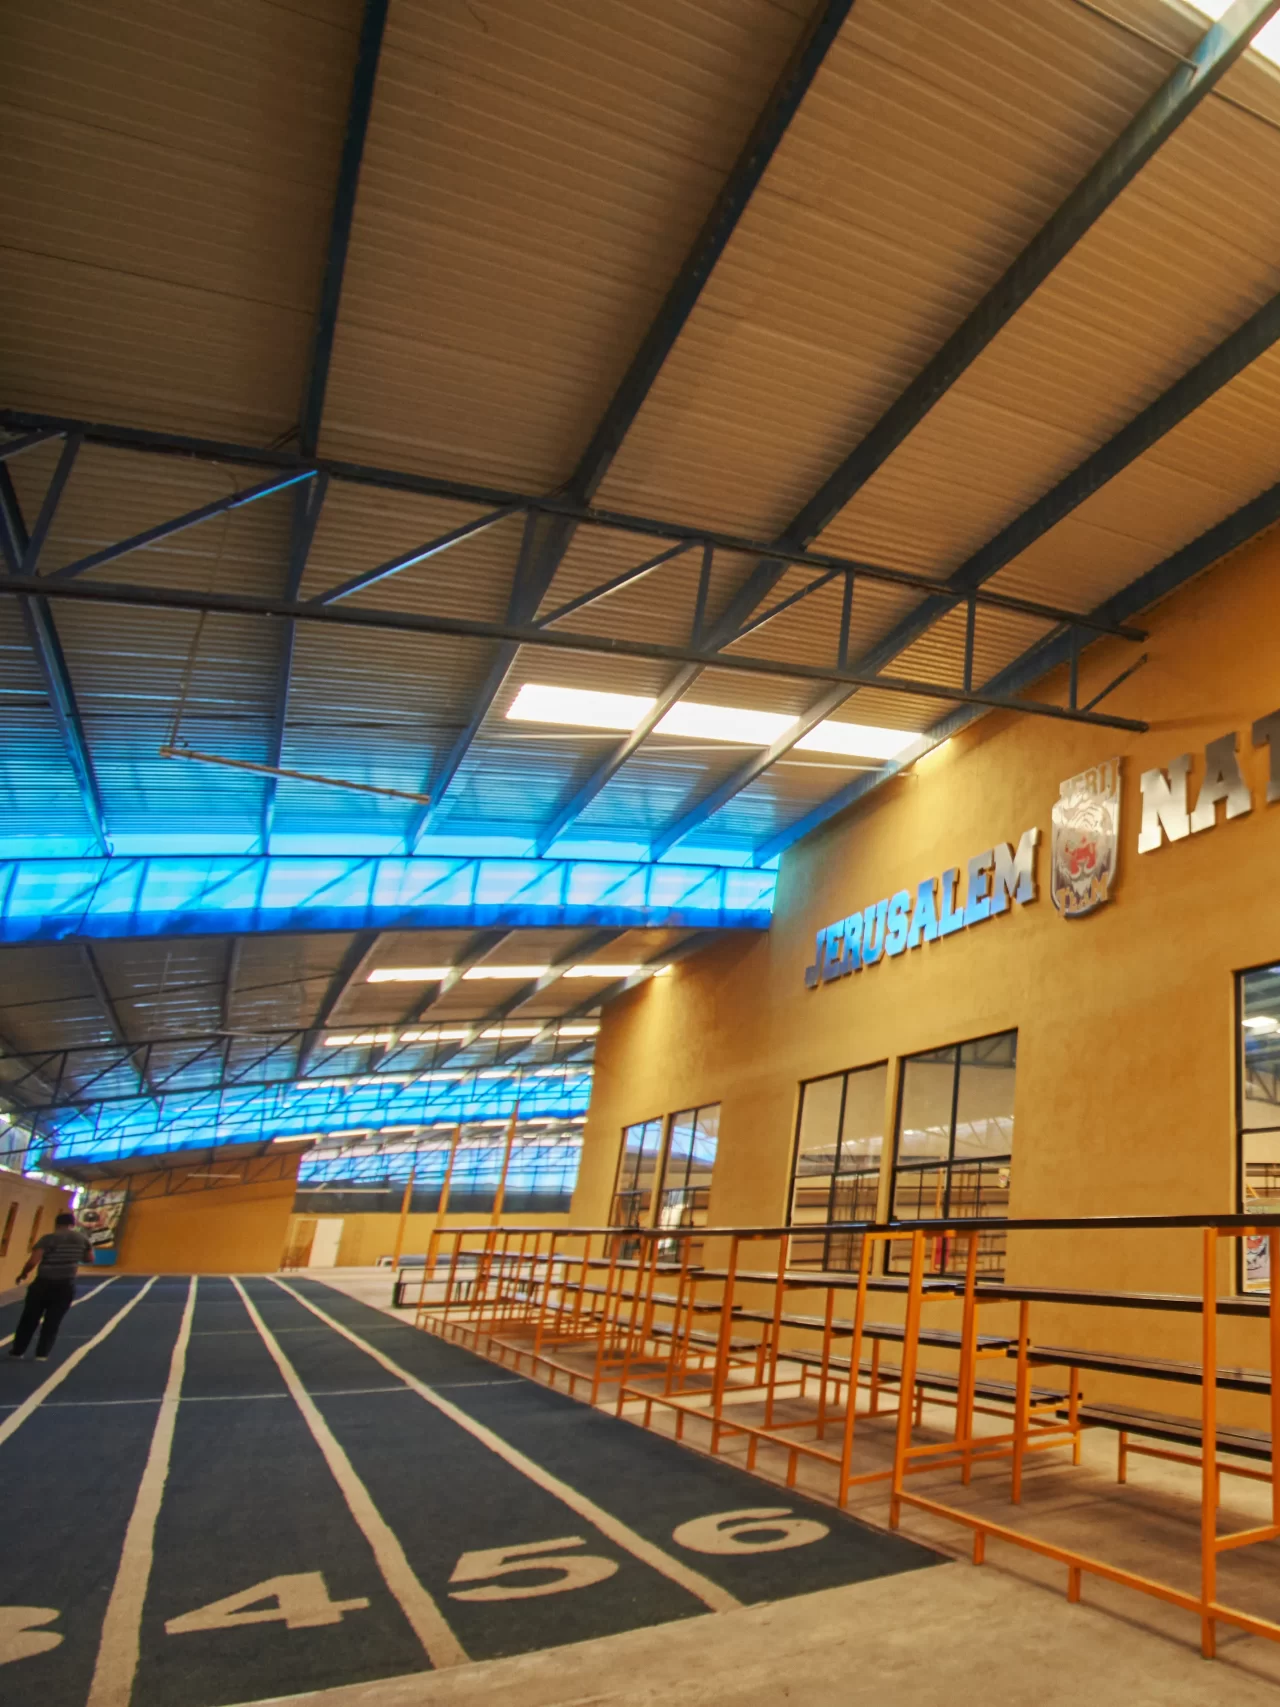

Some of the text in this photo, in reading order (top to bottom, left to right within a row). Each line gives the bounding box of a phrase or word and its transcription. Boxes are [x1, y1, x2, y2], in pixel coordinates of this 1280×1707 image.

[805, 827, 1040, 988] JERUSALEM
[672, 1507, 831, 1555] 6
[447, 1535, 620, 1601] 5
[164, 1571, 370, 1636] 4
